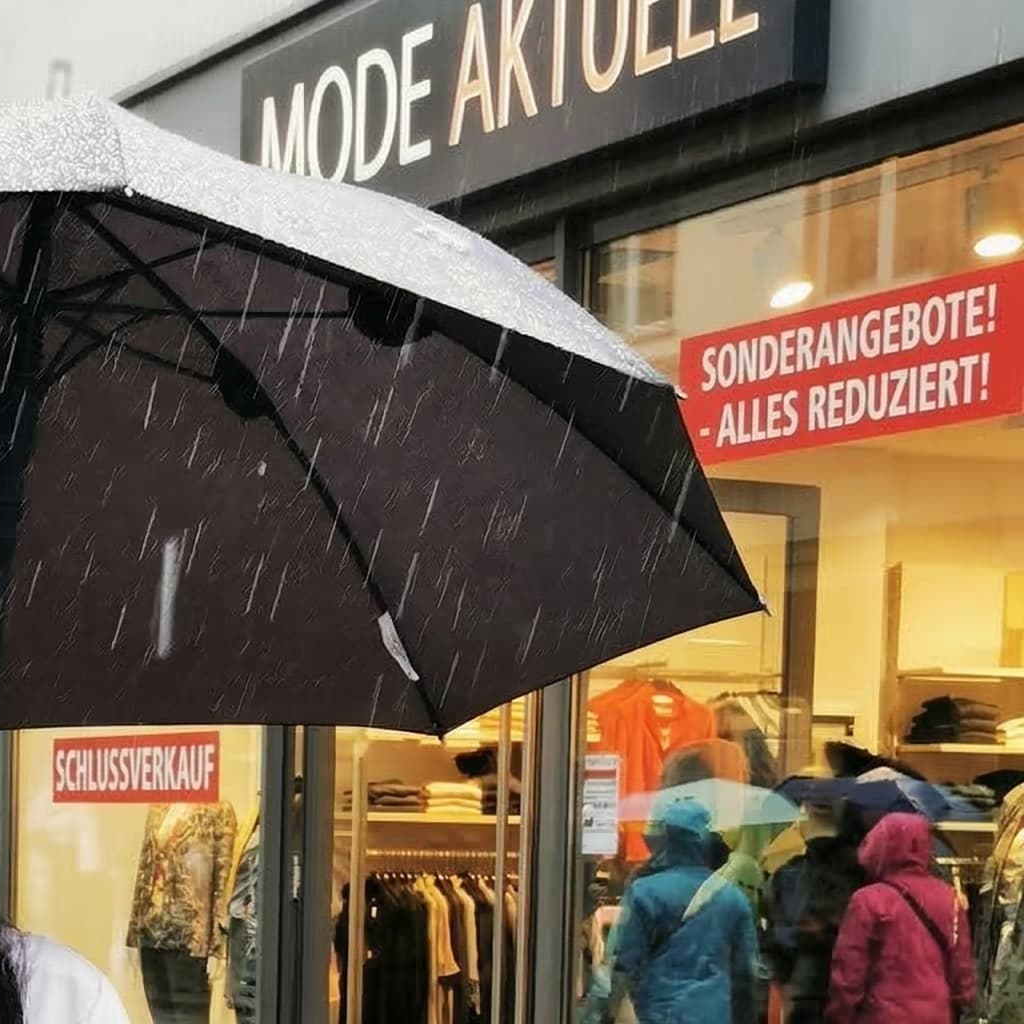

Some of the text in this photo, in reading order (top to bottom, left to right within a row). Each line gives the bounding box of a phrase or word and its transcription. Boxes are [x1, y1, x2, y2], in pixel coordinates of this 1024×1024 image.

[261, 0, 760, 183] MODE AKTUE
[701, 283, 998, 392] SONDERANGEBOTE!
[715, 390, 800, 448] ALLES
[807, 352, 991, 432] REDUZIERT!
[55, 743, 216, 792] SCHLUSSVERKAUF
